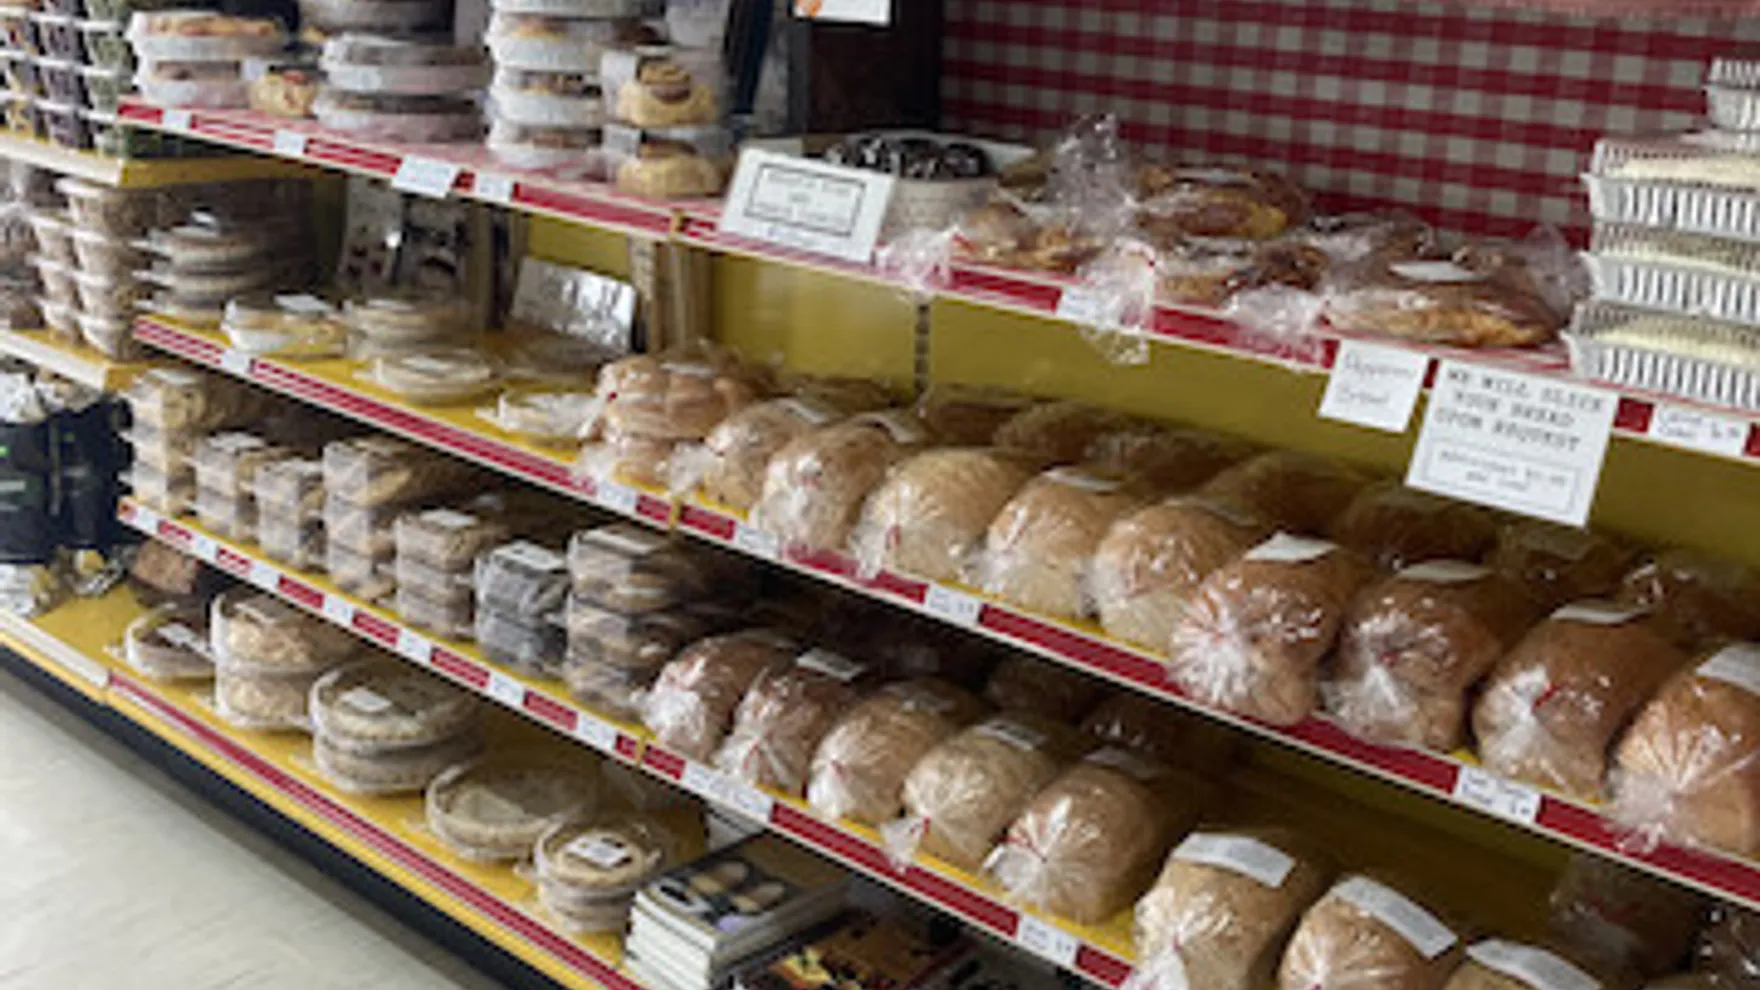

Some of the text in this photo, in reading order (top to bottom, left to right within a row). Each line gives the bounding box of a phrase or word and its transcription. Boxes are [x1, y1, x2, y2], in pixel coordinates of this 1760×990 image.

[1446, 369, 1602, 413] WE WILL SLICE
[1454, 388, 1575, 428] YOUR BREAD
[1433, 405, 1582, 453] UPON REQUEST
